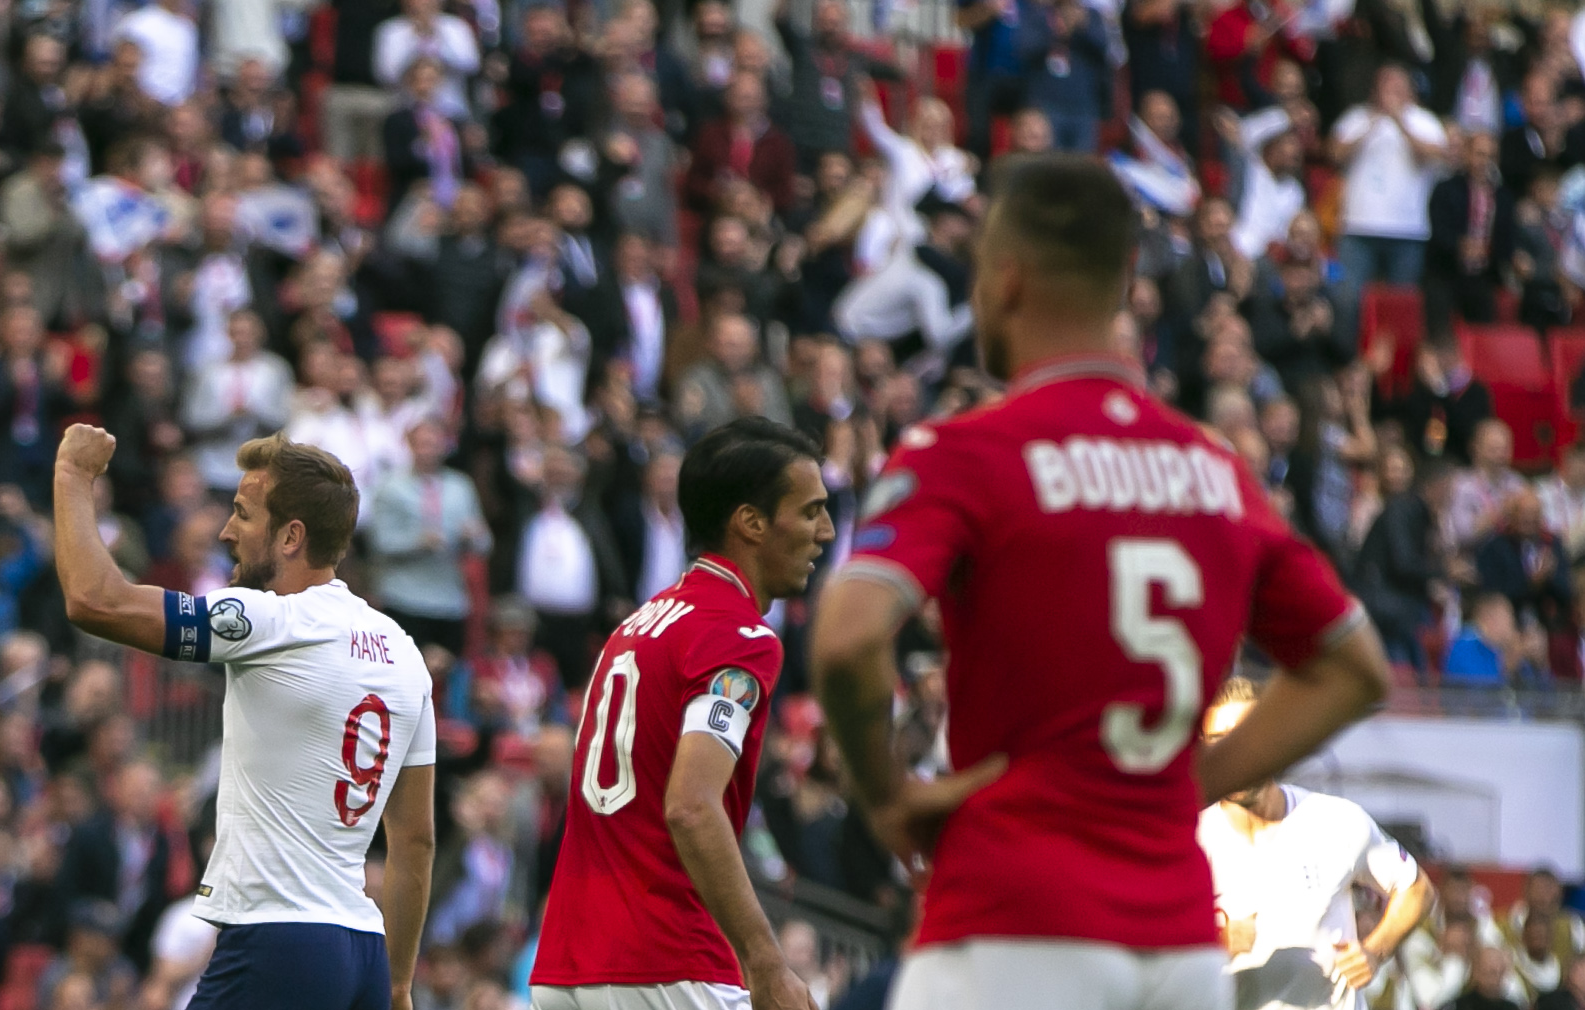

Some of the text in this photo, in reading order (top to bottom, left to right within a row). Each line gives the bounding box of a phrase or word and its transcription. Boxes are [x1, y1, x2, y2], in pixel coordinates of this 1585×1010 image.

[350, 628, 395, 665] KANE
[1103, 540, 1202, 772] 5
[334, 693, 391, 827] 9
[575, 650, 641, 816] 0
[707, 699, 735, 733] C
